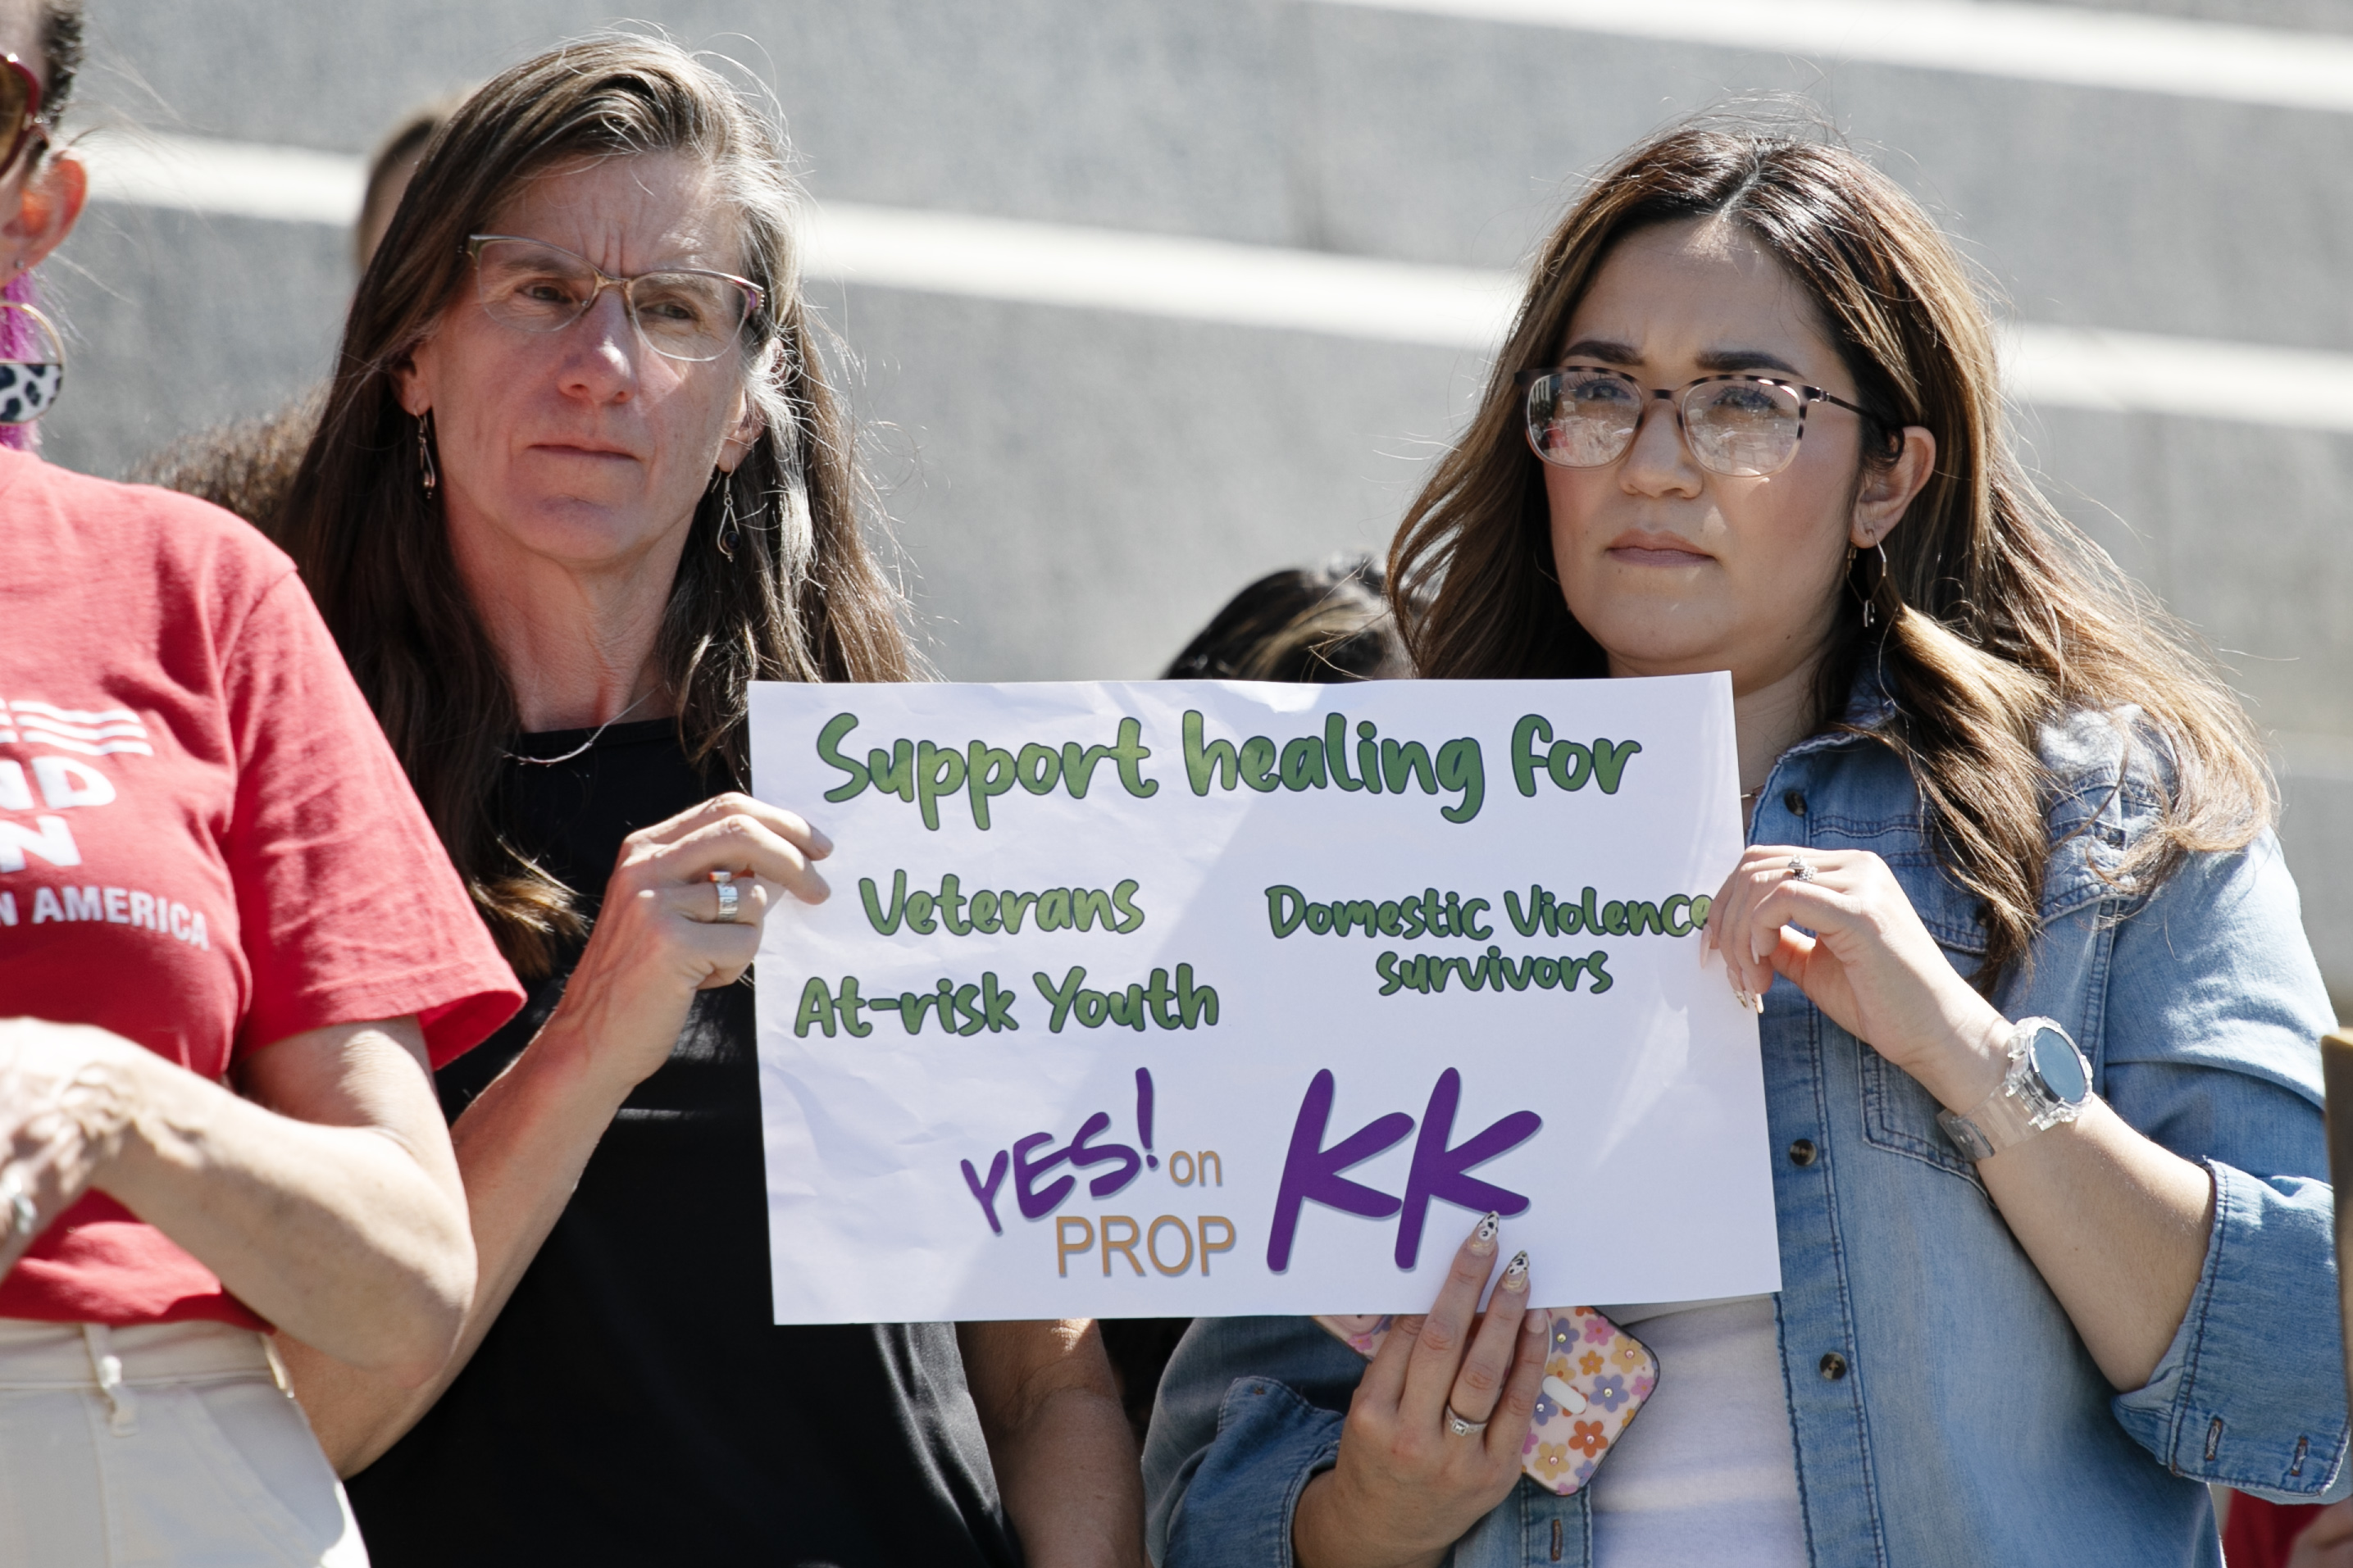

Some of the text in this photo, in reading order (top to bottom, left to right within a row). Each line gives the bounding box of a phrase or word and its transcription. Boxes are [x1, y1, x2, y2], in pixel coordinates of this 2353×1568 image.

[817, 710, 1643, 831] Support healing for
[31, 885, 210, 952] AMERICA
[858, 869, 1145, 936] Veterans
[1264, 884, 1494, 941] Domestic
[794, 962, 1220, 1039] At-risk Youth
[960, 1066, 1223, 1235] YES! on
[1266, 1066, 1543, 1273] KK
[1055, 1215, 1236, 1277] PROP
